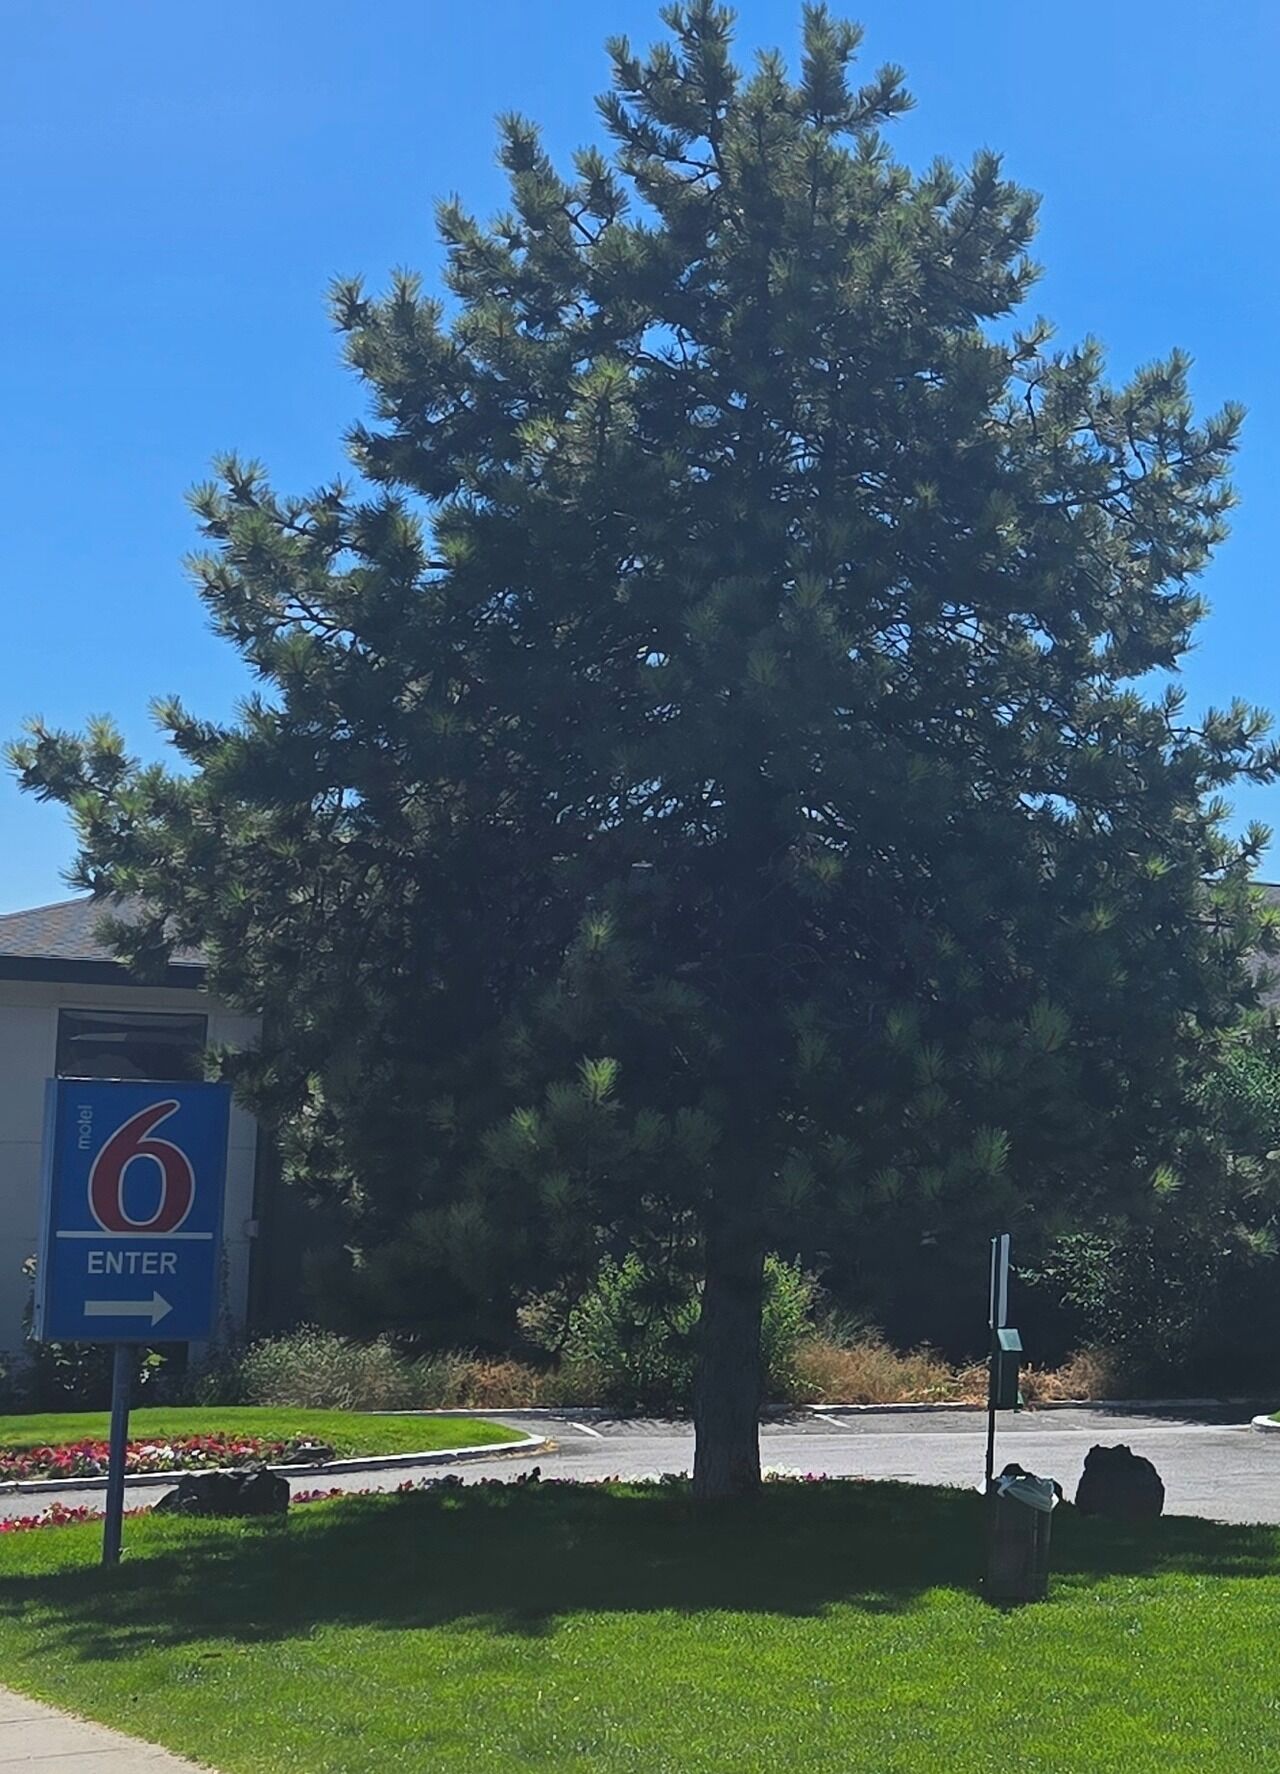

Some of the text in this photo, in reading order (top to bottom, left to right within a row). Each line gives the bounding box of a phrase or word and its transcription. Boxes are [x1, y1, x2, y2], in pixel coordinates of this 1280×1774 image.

[77, 1099, 196, 1234] motel 6
[87, 1251, 177, 1275] ENTER
